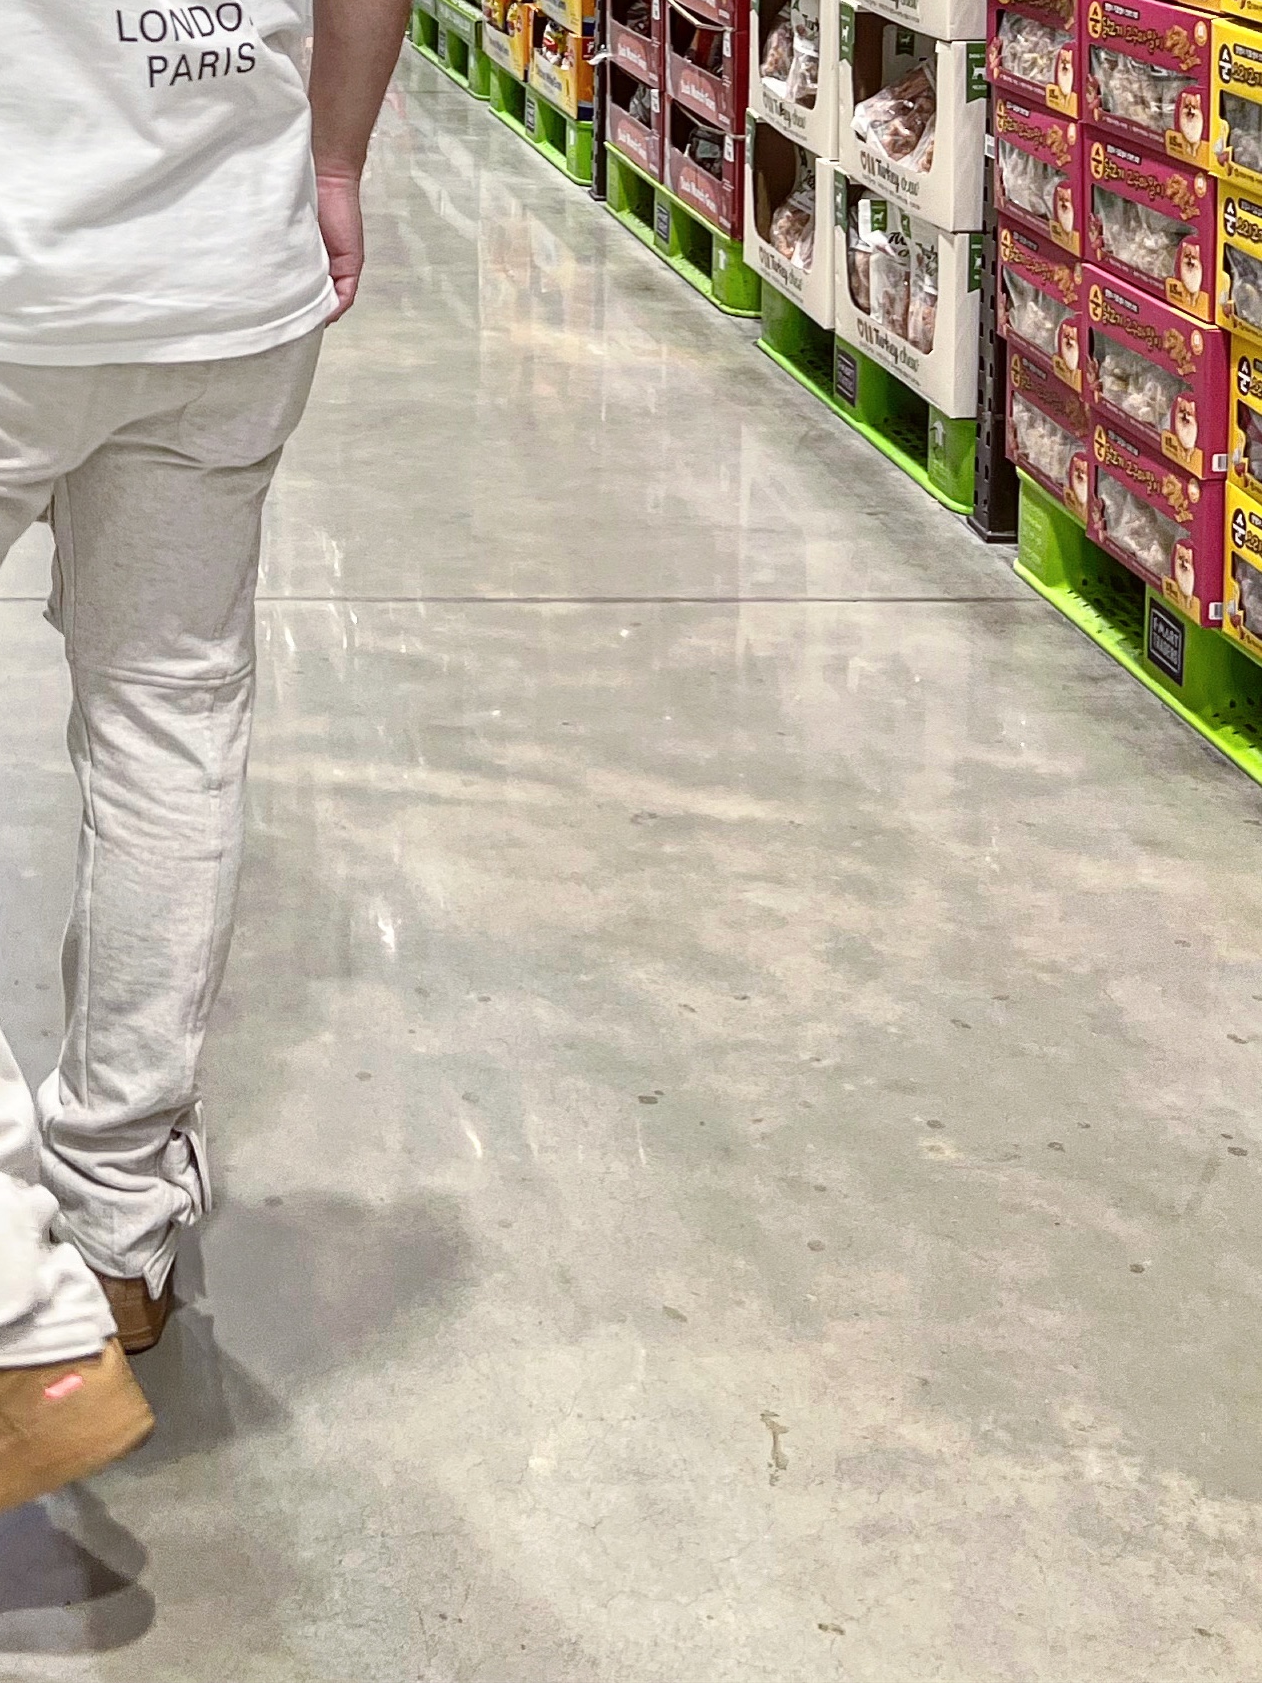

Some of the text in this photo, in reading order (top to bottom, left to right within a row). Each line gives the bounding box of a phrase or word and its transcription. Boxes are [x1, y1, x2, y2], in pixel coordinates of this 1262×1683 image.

[116, 2, 253, 43] LONDO
[147, 42, 256, 88] PARIS
[873, 328, 899, 365] Turkey
